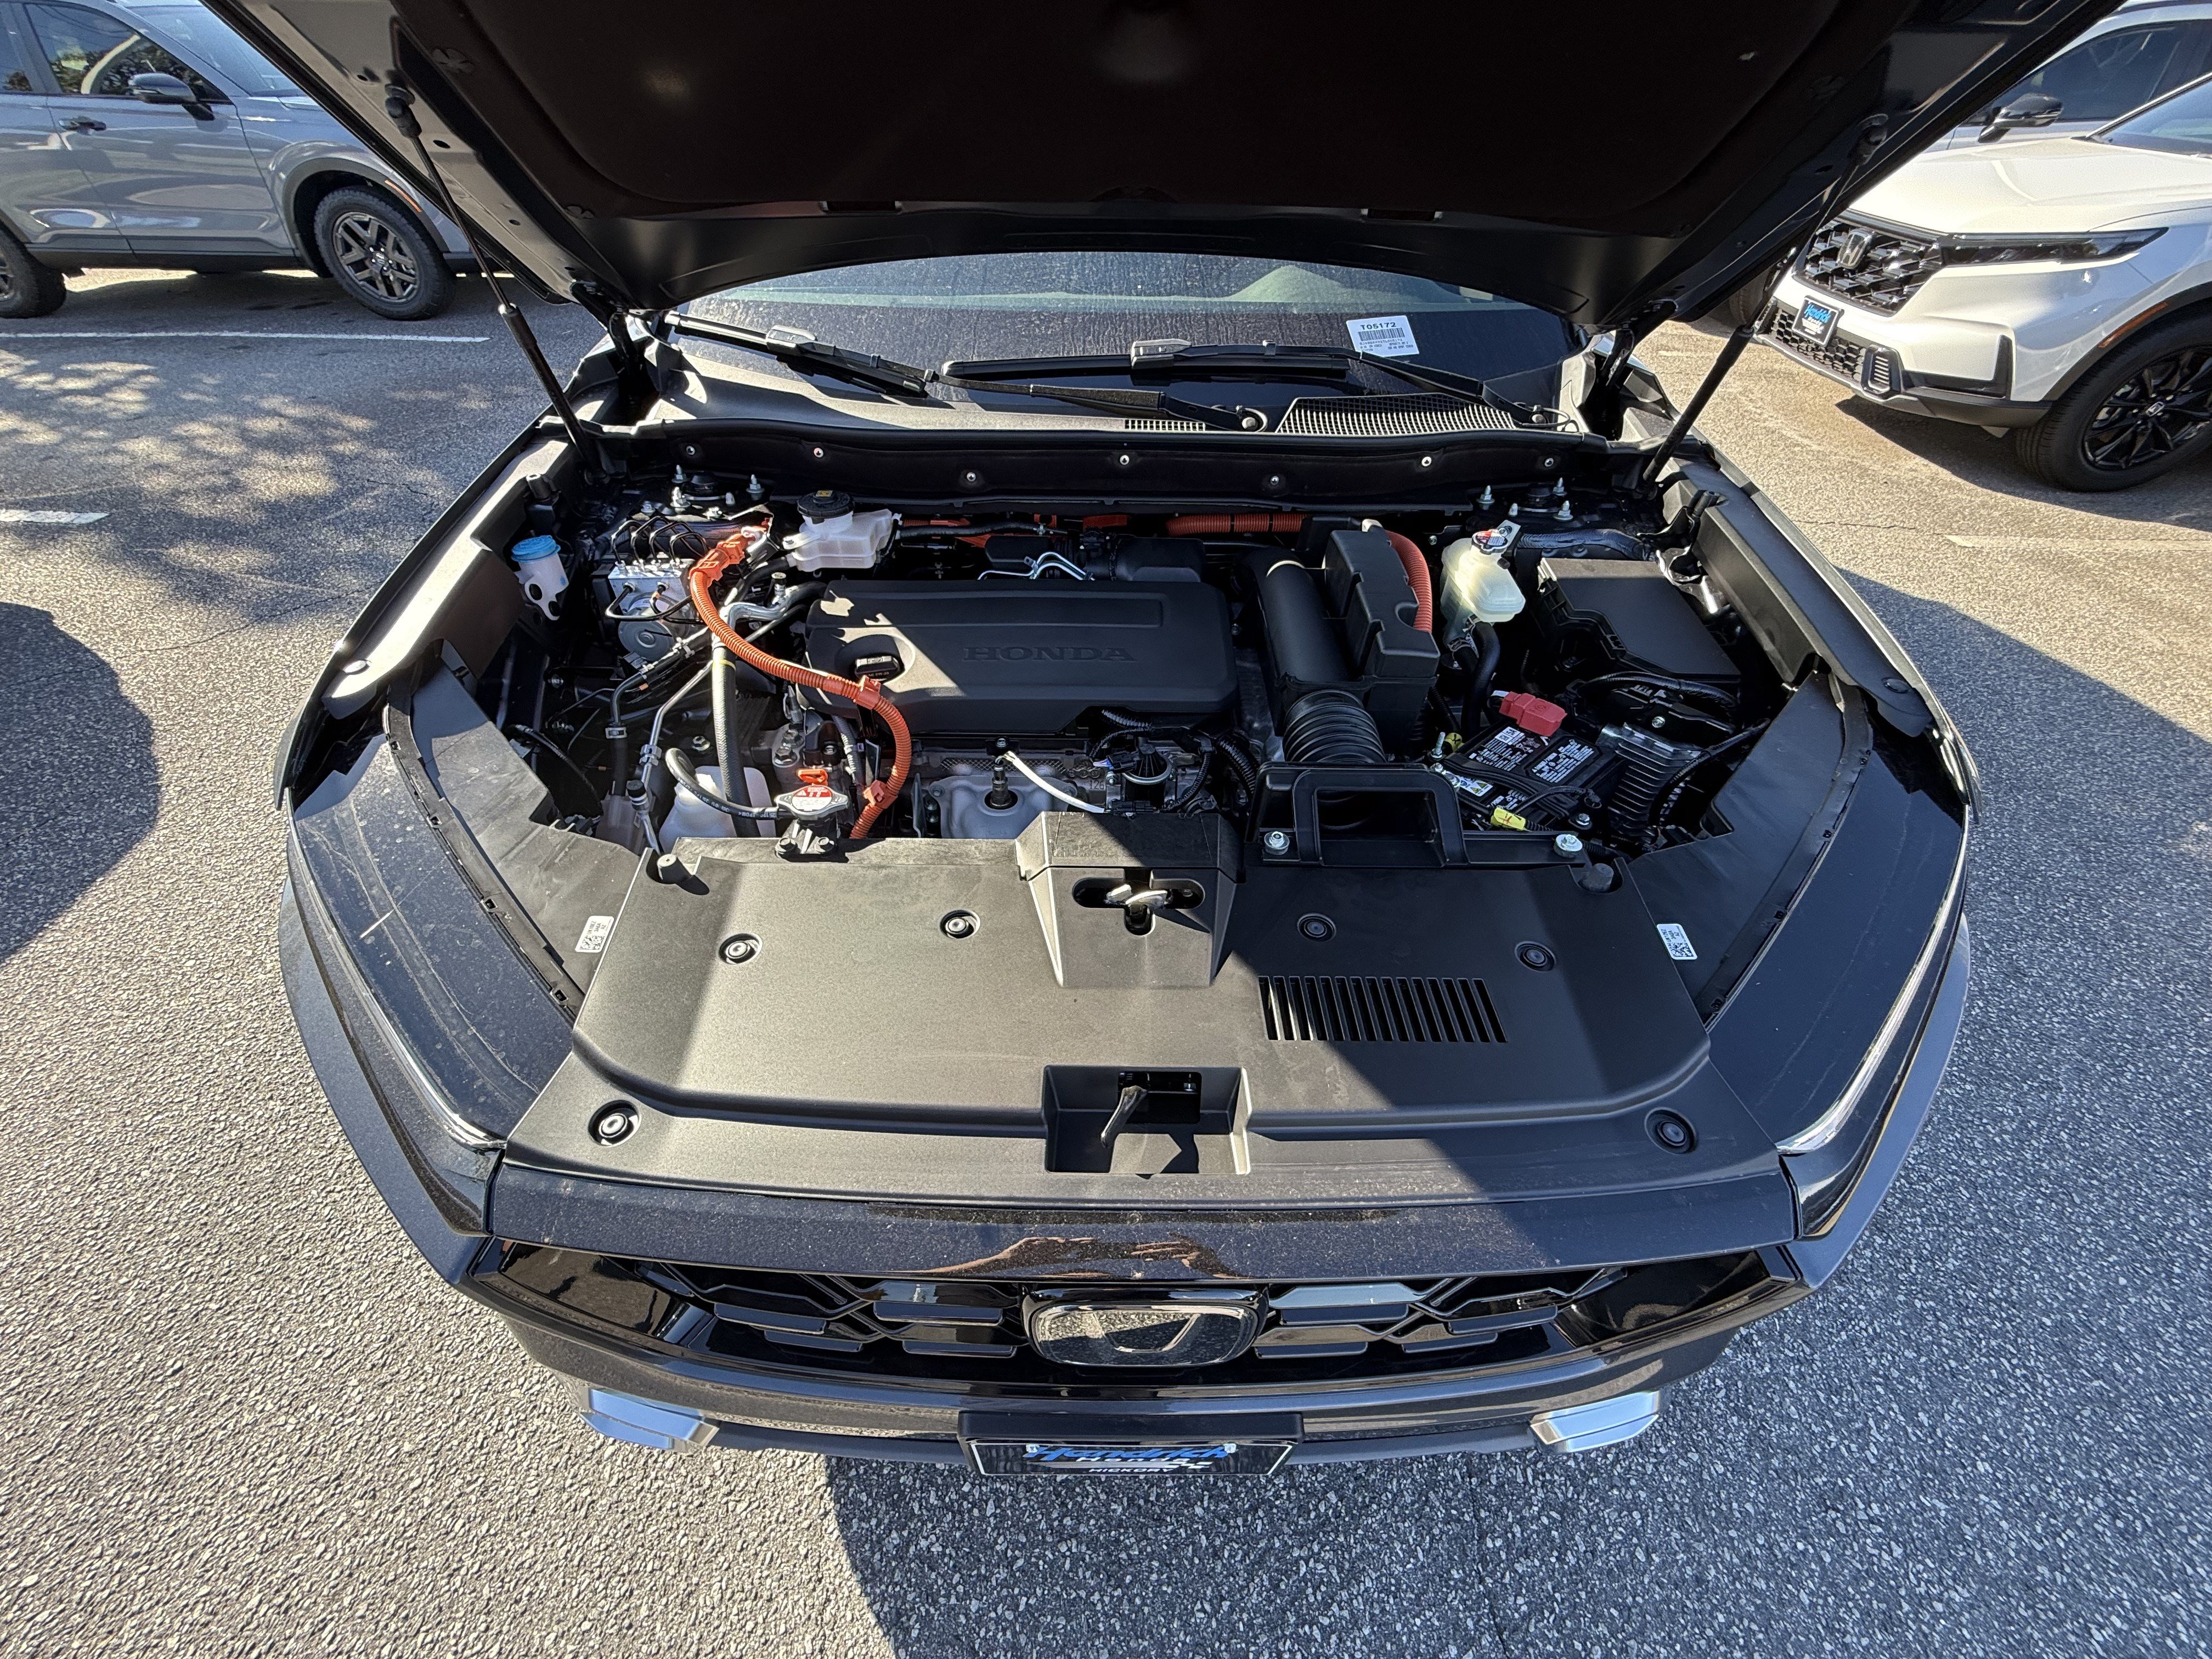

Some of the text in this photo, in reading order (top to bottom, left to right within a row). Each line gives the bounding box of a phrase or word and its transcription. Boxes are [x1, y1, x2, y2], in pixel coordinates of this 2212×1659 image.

[1360, 322, 1397, 330] T05172
[963, 646, 1137, 662] HONDA
[1090, 780, 1105, 789] 126
[1023, 1447, 1229, 1461] Hendrick
